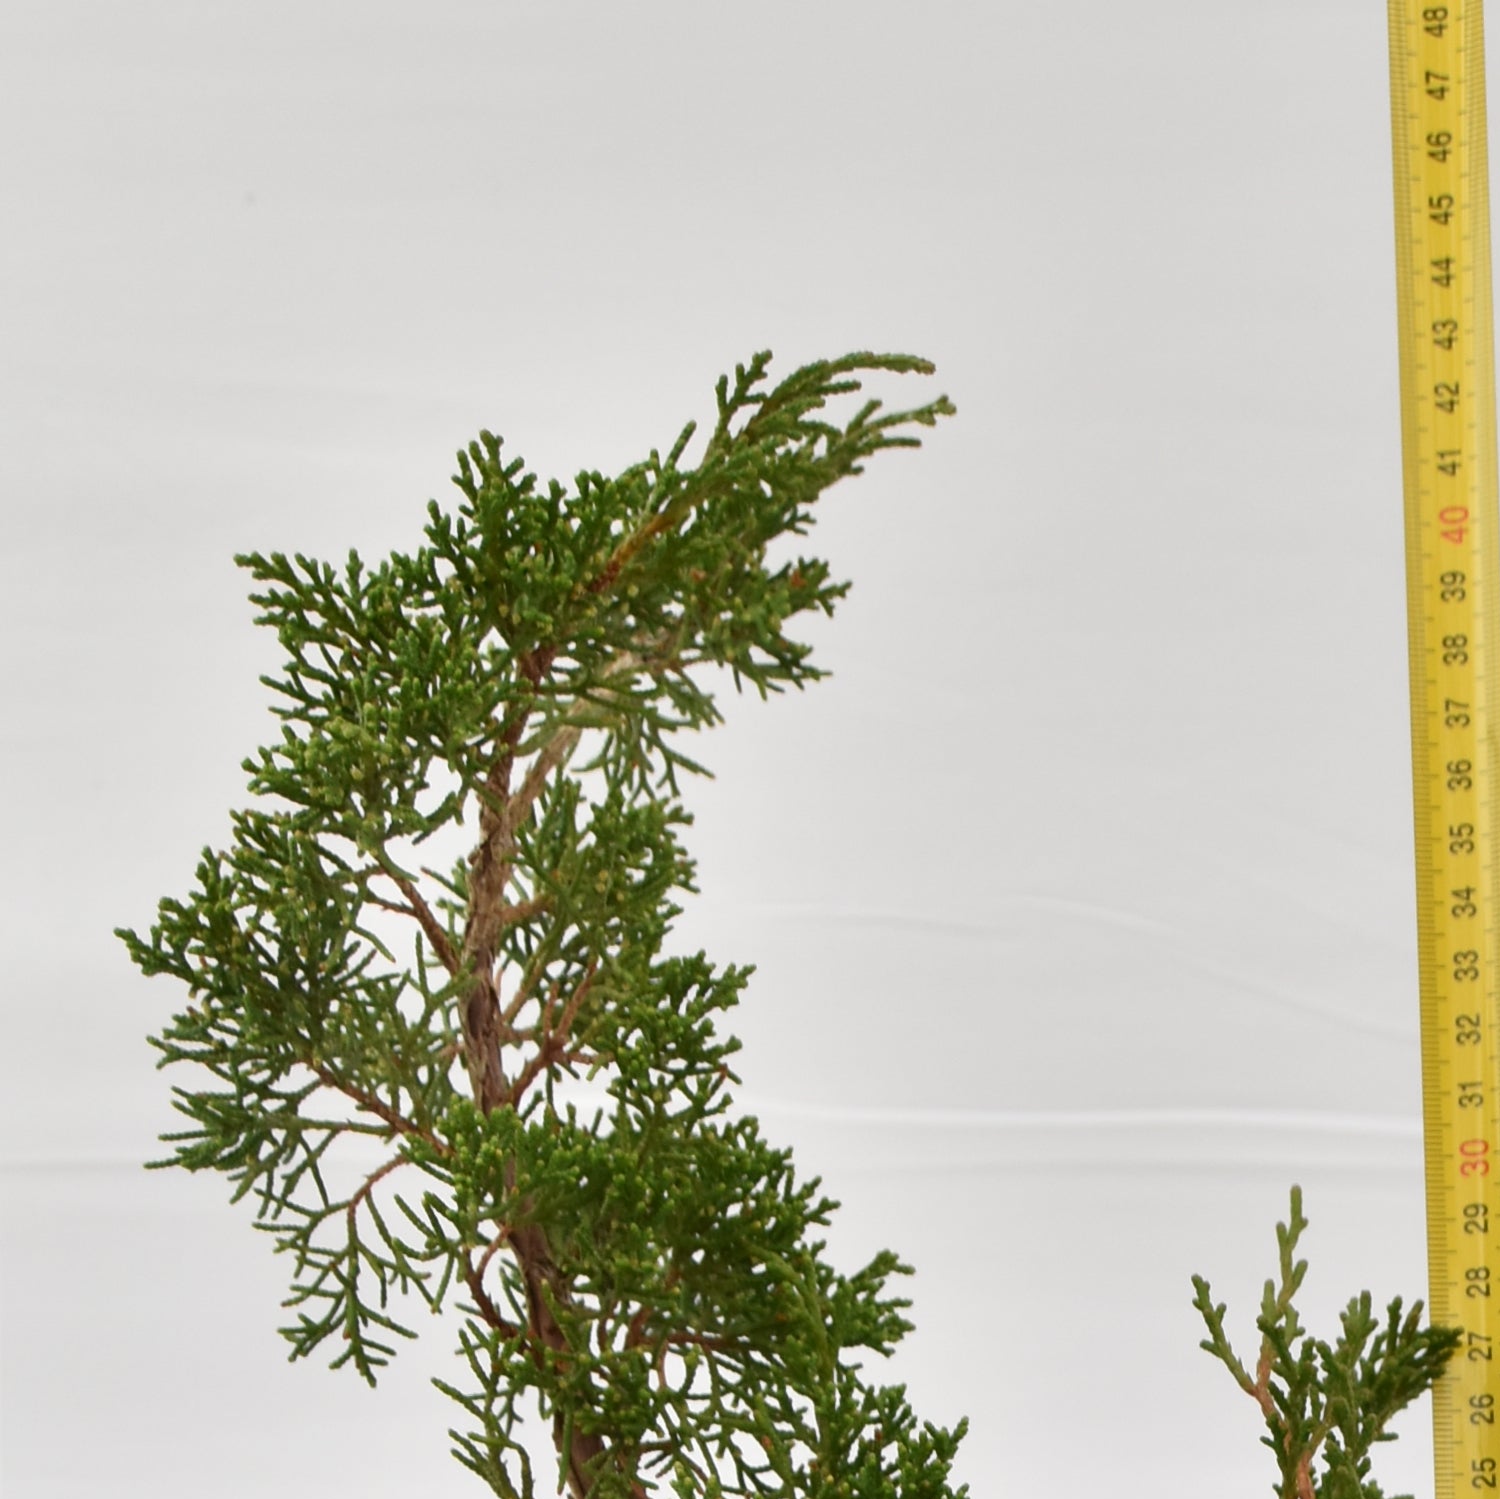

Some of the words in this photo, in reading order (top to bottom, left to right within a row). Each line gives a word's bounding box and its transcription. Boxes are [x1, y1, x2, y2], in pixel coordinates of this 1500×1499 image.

[1422, 7, 1449, 38] 48
[1424, 70, 1449, 101] 47
[1425, 132, 1452, 164] 46
[1428, 194, 1454, 226] 45
[1430, 256, 1453, 288] 44
[1431, 319, 1458, 351] 43
[1433, 382, 1460, 415] 42
[1436, 450, 1461, 477] 41
[1438, 505, 1469, 545] 40
[1439, 571, 1466, 603] 39
[1441, 634, 1469, 666] 38
[1444, 698, 1471, 729] 37
[1446, 759, 1473, 791] 36
[1448, 823, 1475, 855] 35
[1451, 886, 1477, 918] 34
[1452, 949, 1480, 982] 33
[1455, 1014, 1482, 1046] 32
[1457, 1082, 1484, 1109] 31
[1459, 1139, 1490, 1177] 30
[1462, 1203, 1489, 1235] 29
[1464, 1266, 1491, 1298] 28
[1467, 1331, 1493, 1362] 27
[1468, 1393, 1495, 1426] 26
[1471, 1457, 1497, 1489] 25
